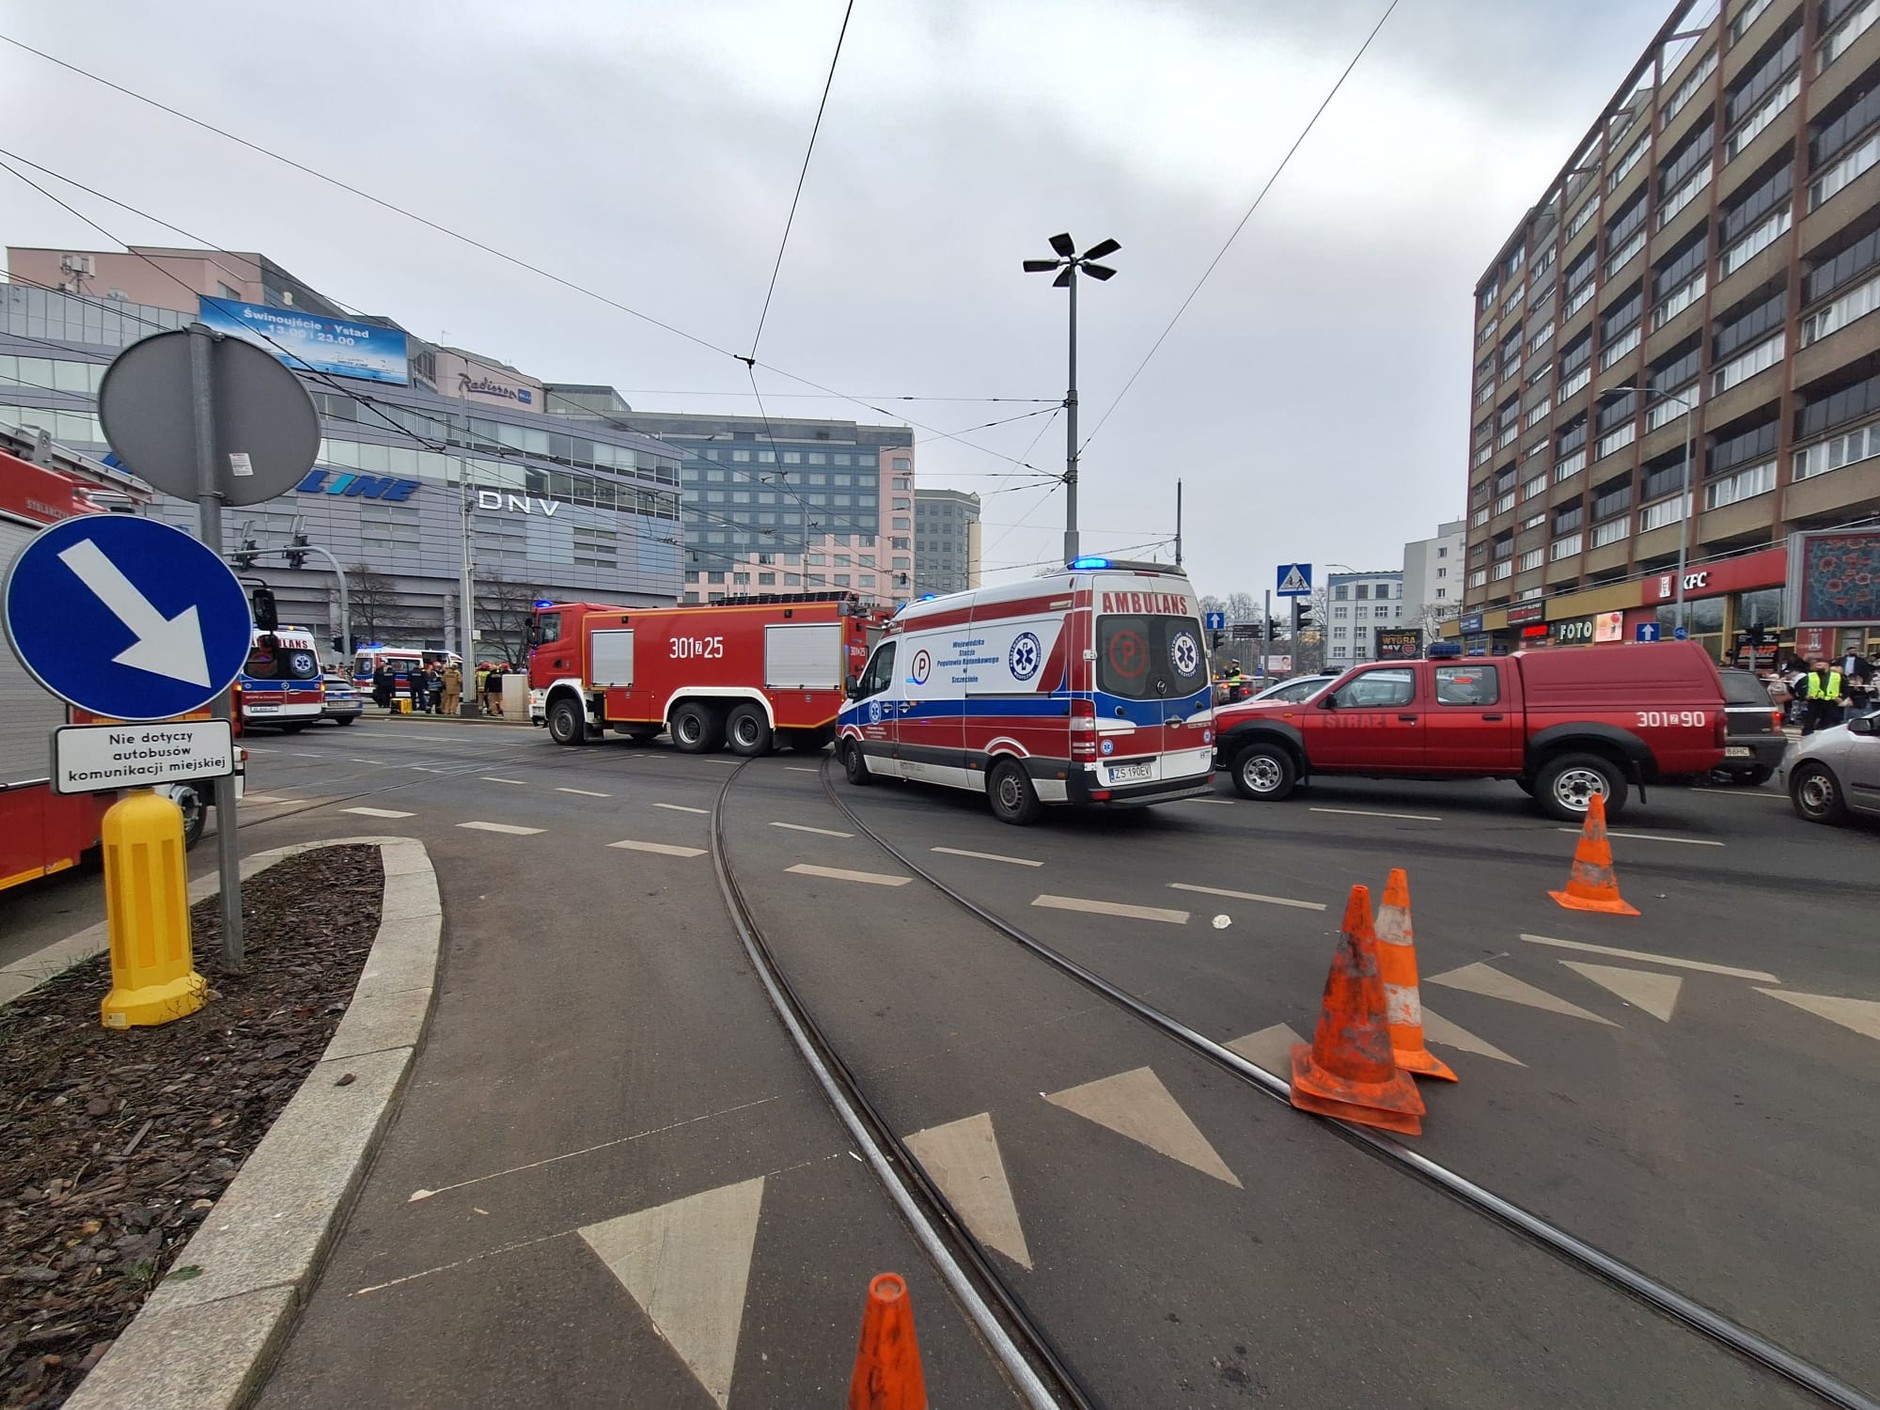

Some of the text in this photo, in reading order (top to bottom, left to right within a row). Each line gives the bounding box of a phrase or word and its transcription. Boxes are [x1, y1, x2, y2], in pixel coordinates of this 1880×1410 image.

[243, 308, 370, 339] Świnoujście Ystad
[268, 324, 307, 338] 13.00
[317, 333, 355, 347] 23.00
[458, 373, 517, 400] Radisson
[296, 470, 422, 501] LINE
[478, 490, 560, 517] DNV
[1102, 592, 1188, 615] AMBULANS
[1560, 621, 1592, 640] FOTO
[109, 731, 193, 745] Nie dotyczy
[113, 746, 191, 761] autobusów
[68, 756, 226, 782] komunikacji miejskiej
[1114, 766, 1150, 779] ZS 190EV
